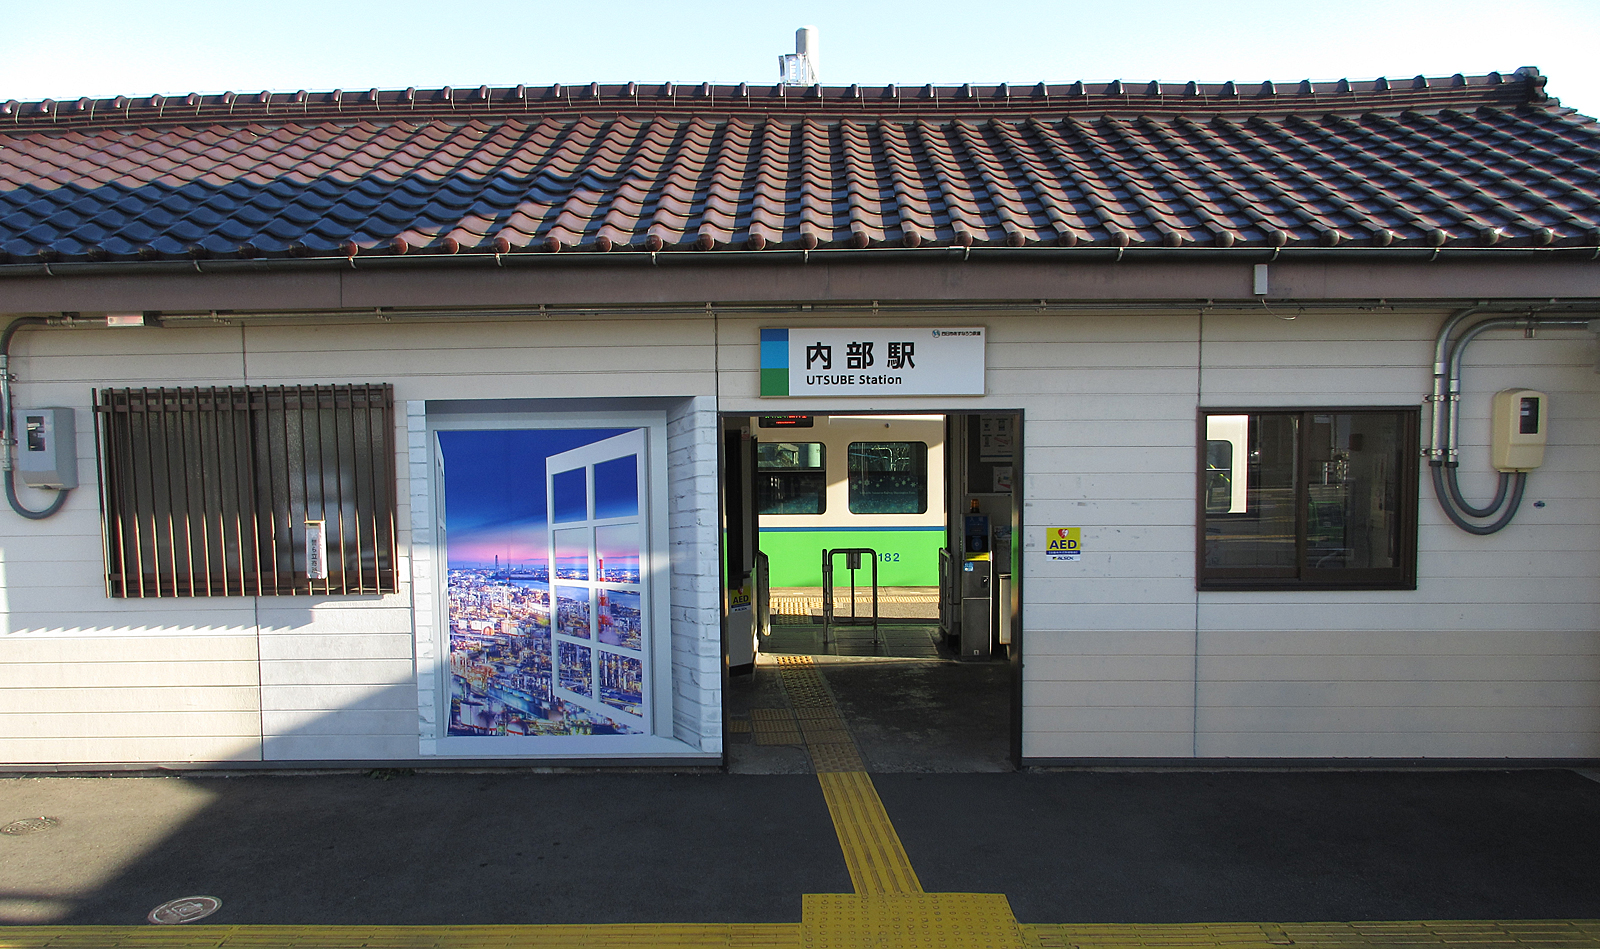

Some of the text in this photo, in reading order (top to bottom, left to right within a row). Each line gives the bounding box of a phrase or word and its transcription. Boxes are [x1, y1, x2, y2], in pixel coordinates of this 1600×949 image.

[806, 341, 915, 370] 内部駅
[806, 374, 902, 385] UTSUBE Station
[1049, 539, 1077, 549] AED
[878, 552, 900, 562] 182
[733, 595, 749, 604] AED
